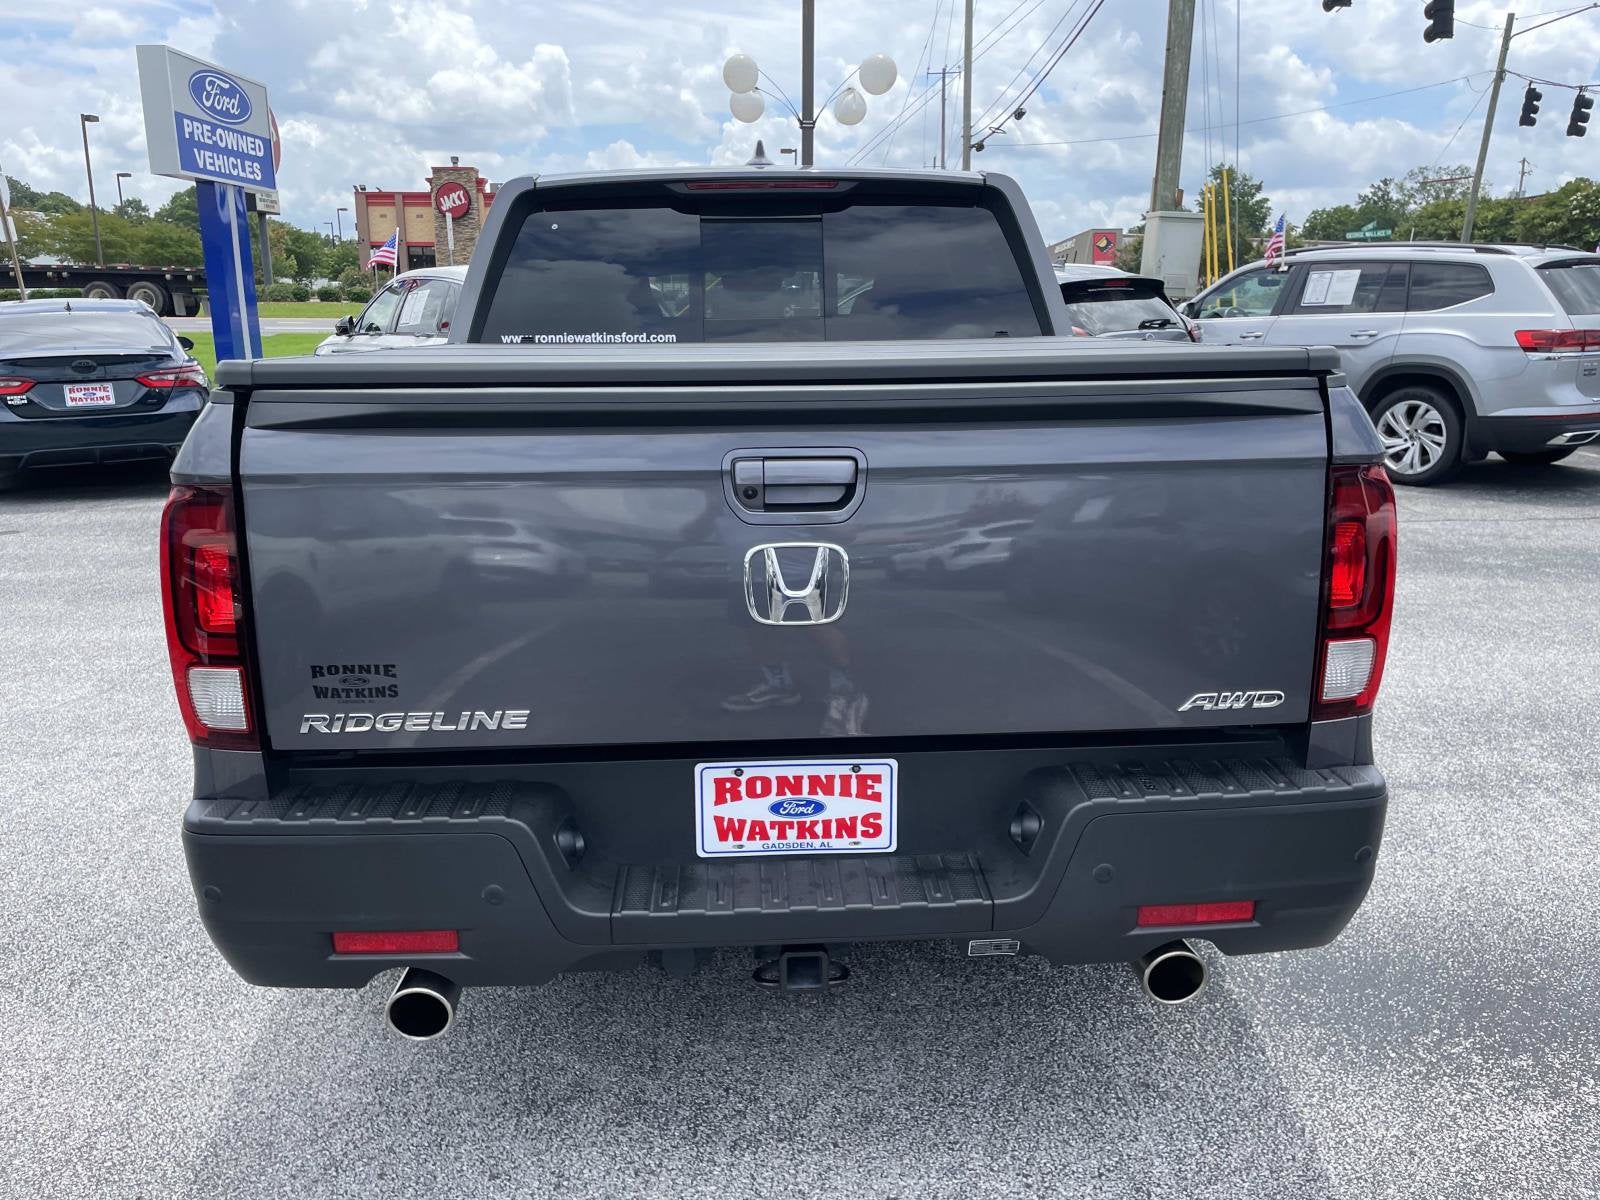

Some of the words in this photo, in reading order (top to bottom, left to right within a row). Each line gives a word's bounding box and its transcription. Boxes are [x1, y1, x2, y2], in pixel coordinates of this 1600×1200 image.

[202, 76, 241, 116] Ford
[183, 118, 265, 158] PRE-OWNED
[193, 148, 262, 182] VEHICLES
[68, 386, 110, 395] RONNIE
[69, 395, 111, 403] WATKINS
[310, 664, 397, 679] RONNIE
[312, 684, 399, 699] WATKINS
[1177, 690, 1286, 712] AWD
[299, 709, 531, 734] RIDGELINE
[713, 773, 882, 806] RONNIE
[779, 799, 815, 815] Ford
[713, 811, 883, 843] WATKINS
[762, 842, 817, 850] GADSDEN,
